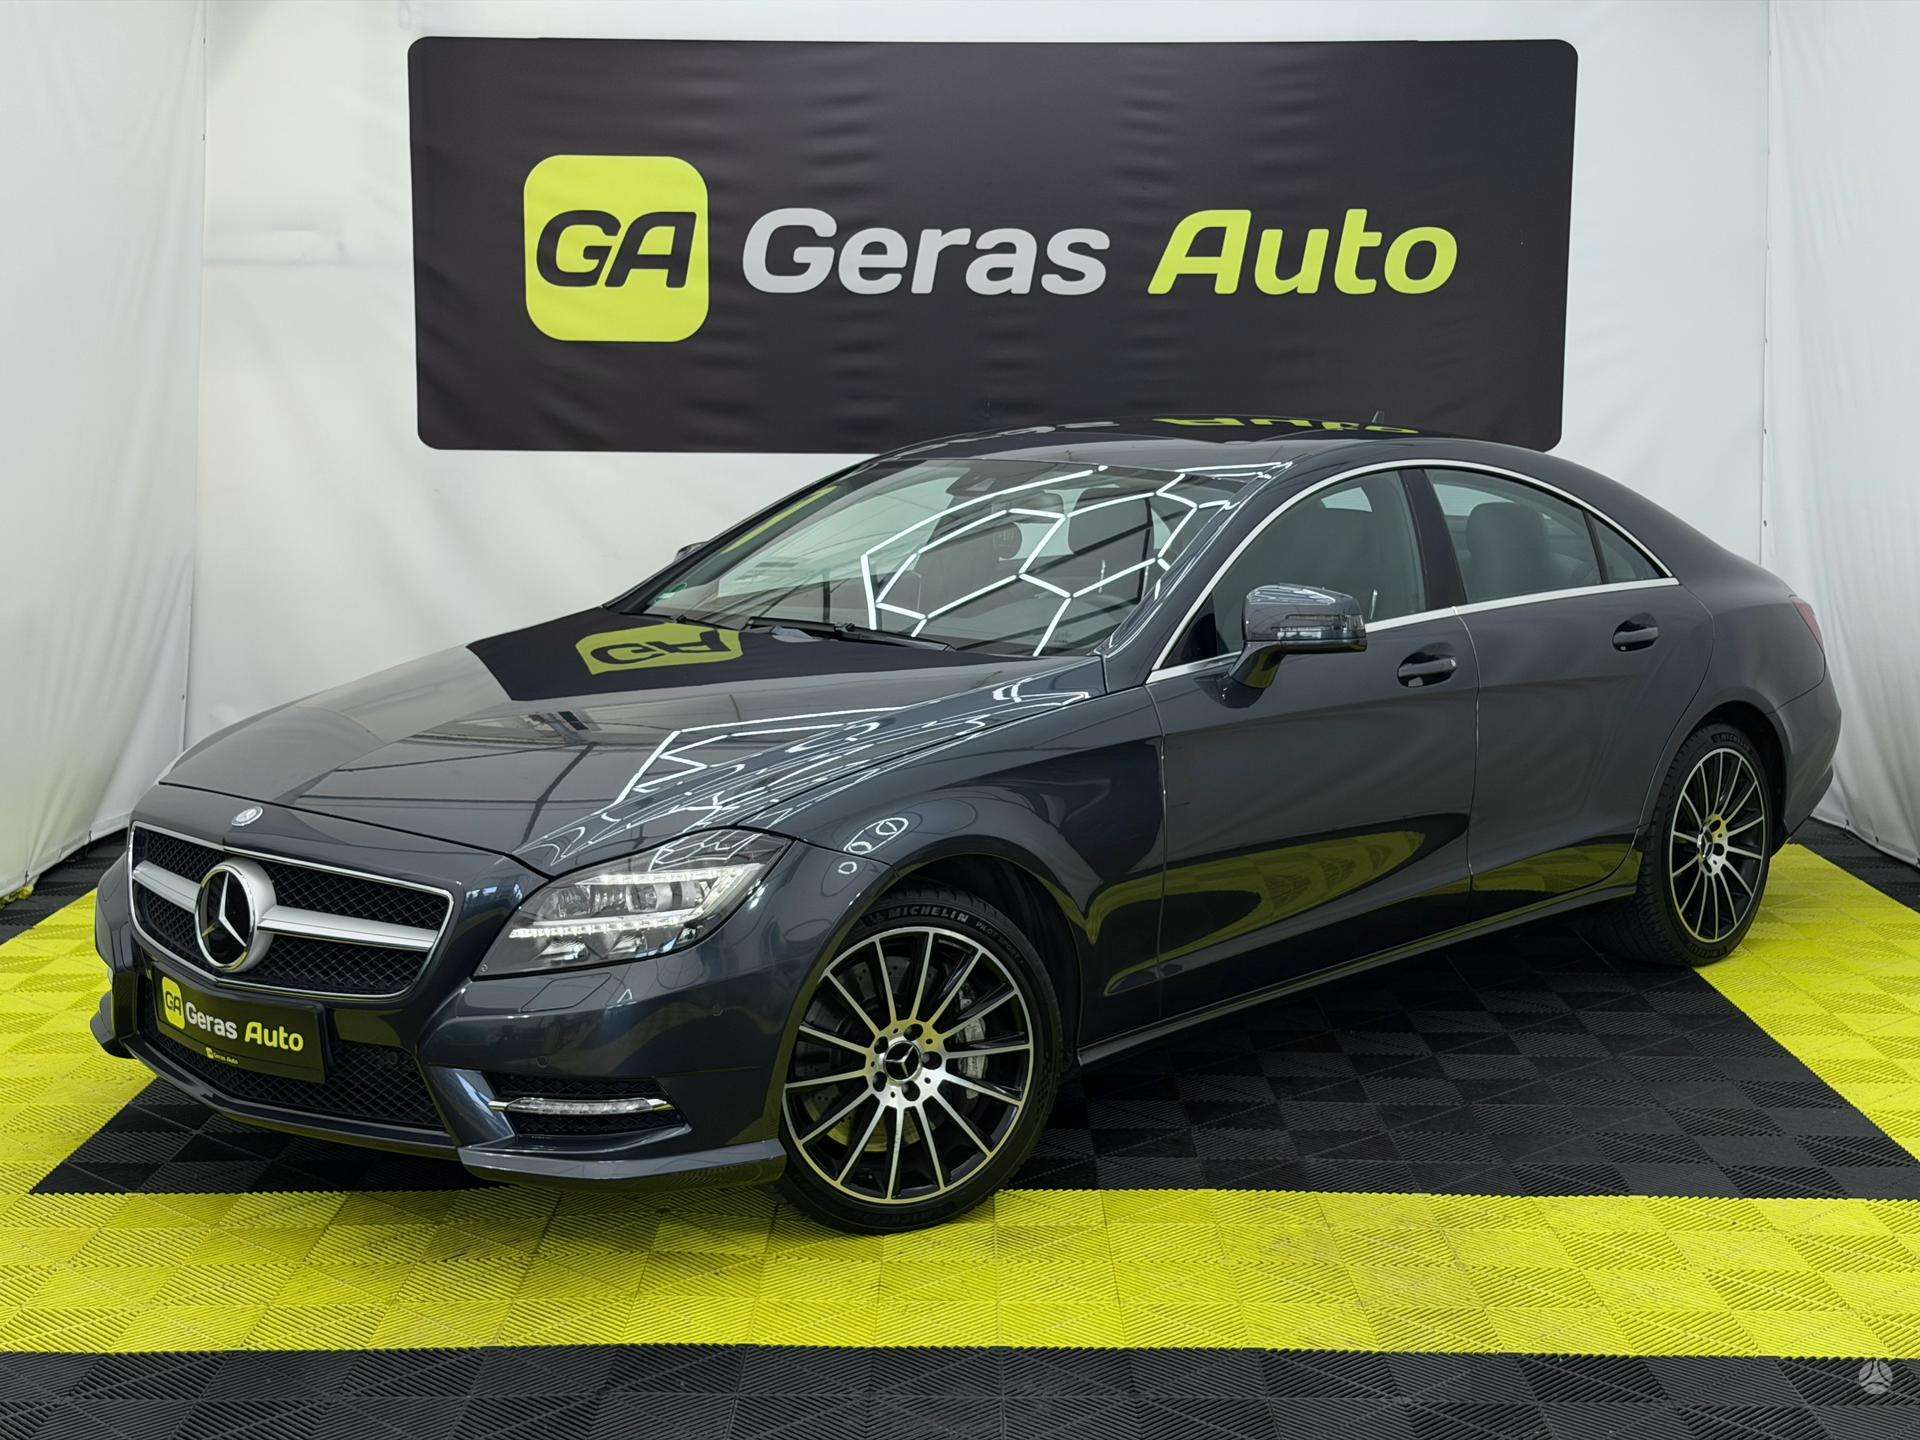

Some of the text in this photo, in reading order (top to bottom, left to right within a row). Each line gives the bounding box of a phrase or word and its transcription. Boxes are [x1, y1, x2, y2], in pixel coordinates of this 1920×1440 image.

[536, 207, 1459, 296] GA Geras Auto
[888, 905, 969, 923] MICHELIN
[165, 990, 304, 1052] GA Geras Auto
